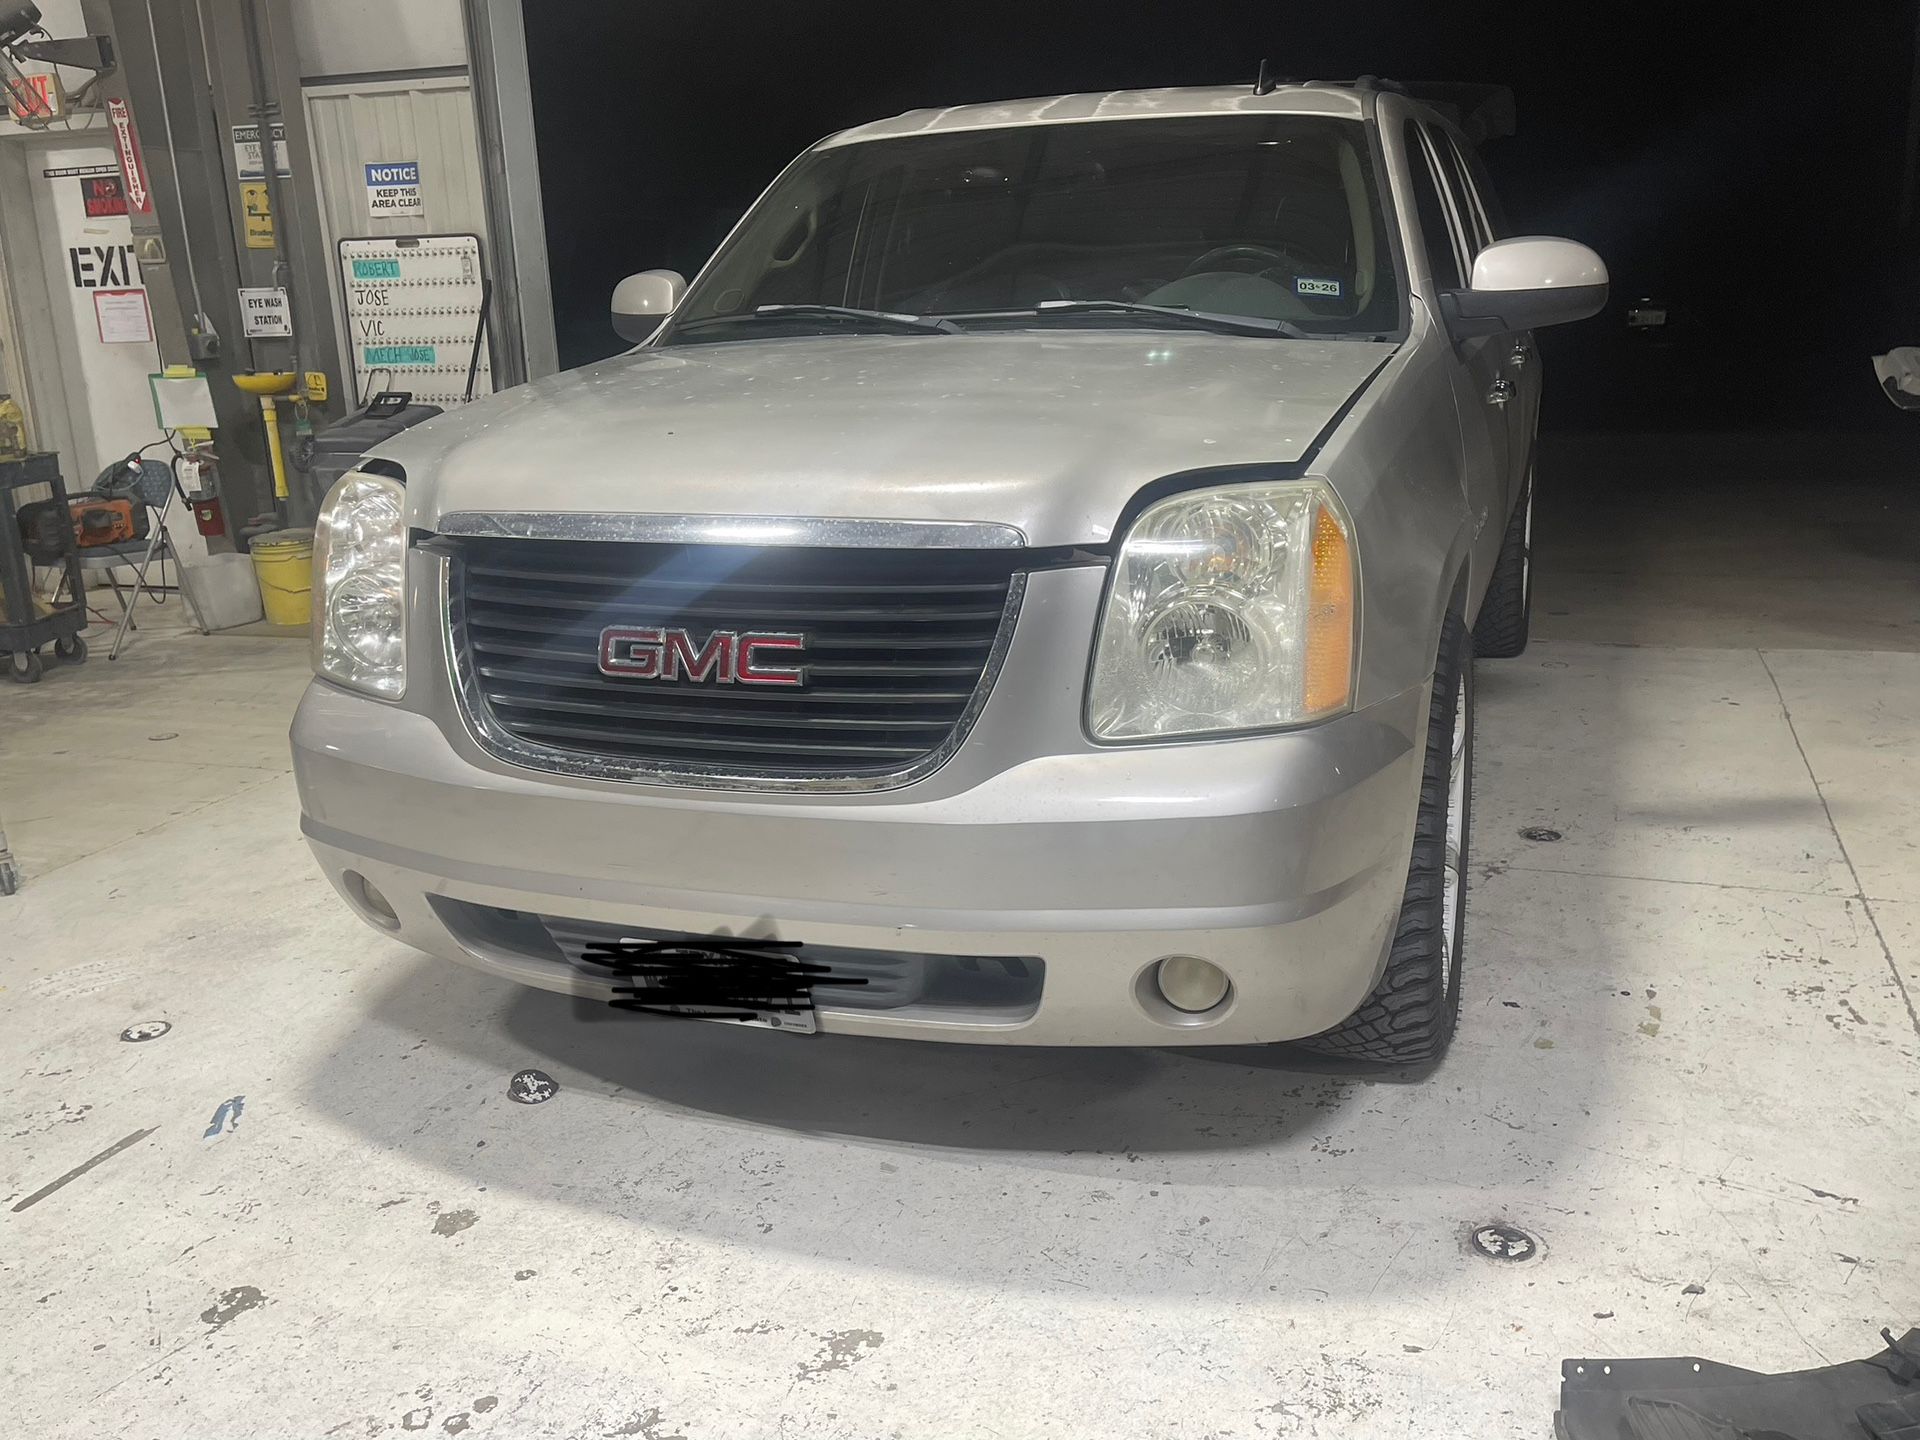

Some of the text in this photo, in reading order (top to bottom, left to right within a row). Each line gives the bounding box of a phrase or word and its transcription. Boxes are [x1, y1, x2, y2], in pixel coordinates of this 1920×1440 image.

[112, 107, 127, 118] FIRE
[119, 122, 143, 203] EXTINGUISHER
[371, 167, 416, 182] NOTICE
[376, 188, 417, 198] KEEP THIS
[371, 198, 421, 208] AREA CLEAR
[357, 261, 399, 276] ROBERT
[248, 298, 282, 308] EYE WASH
[355, 289, 389, 306] JOSE
[254, 315, 282, 325] STATION
[360, 320, 385, 336] VIC
[410, 348, 431, 361] JOSE
[598, 625, 804, 686] GMC
